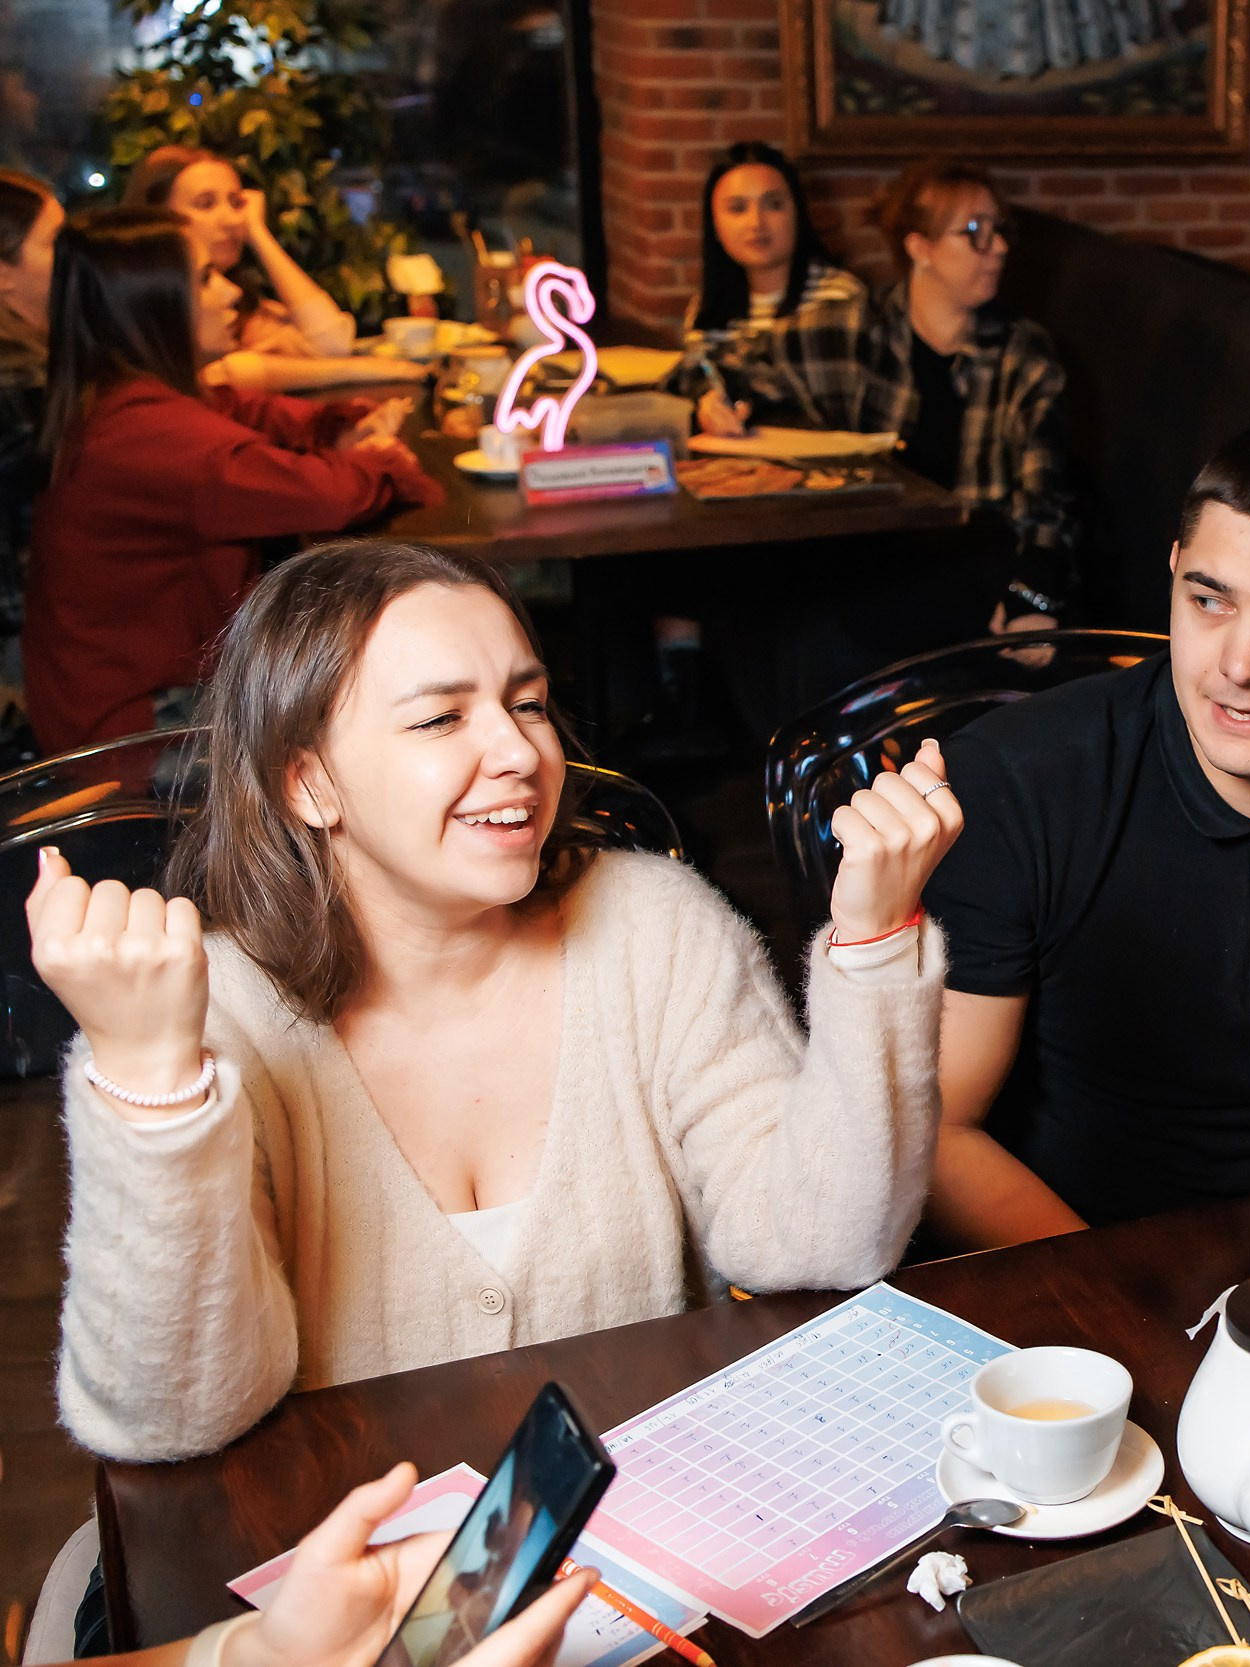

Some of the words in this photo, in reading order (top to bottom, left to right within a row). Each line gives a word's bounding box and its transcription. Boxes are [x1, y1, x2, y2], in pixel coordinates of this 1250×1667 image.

[878, 1307, 892, 1315] 10
[945, 1338, 956, 1346] 6
[916, 1471, 930, 1480] ТУР
[878, 1495, 891, 1505] ТУР
[886, 1500, 898, 1508] 5
[846, 1527, 858, 1535] 6
[808, 1552, 819, 1560] 7
[760, 1549, 857, 1608] music
